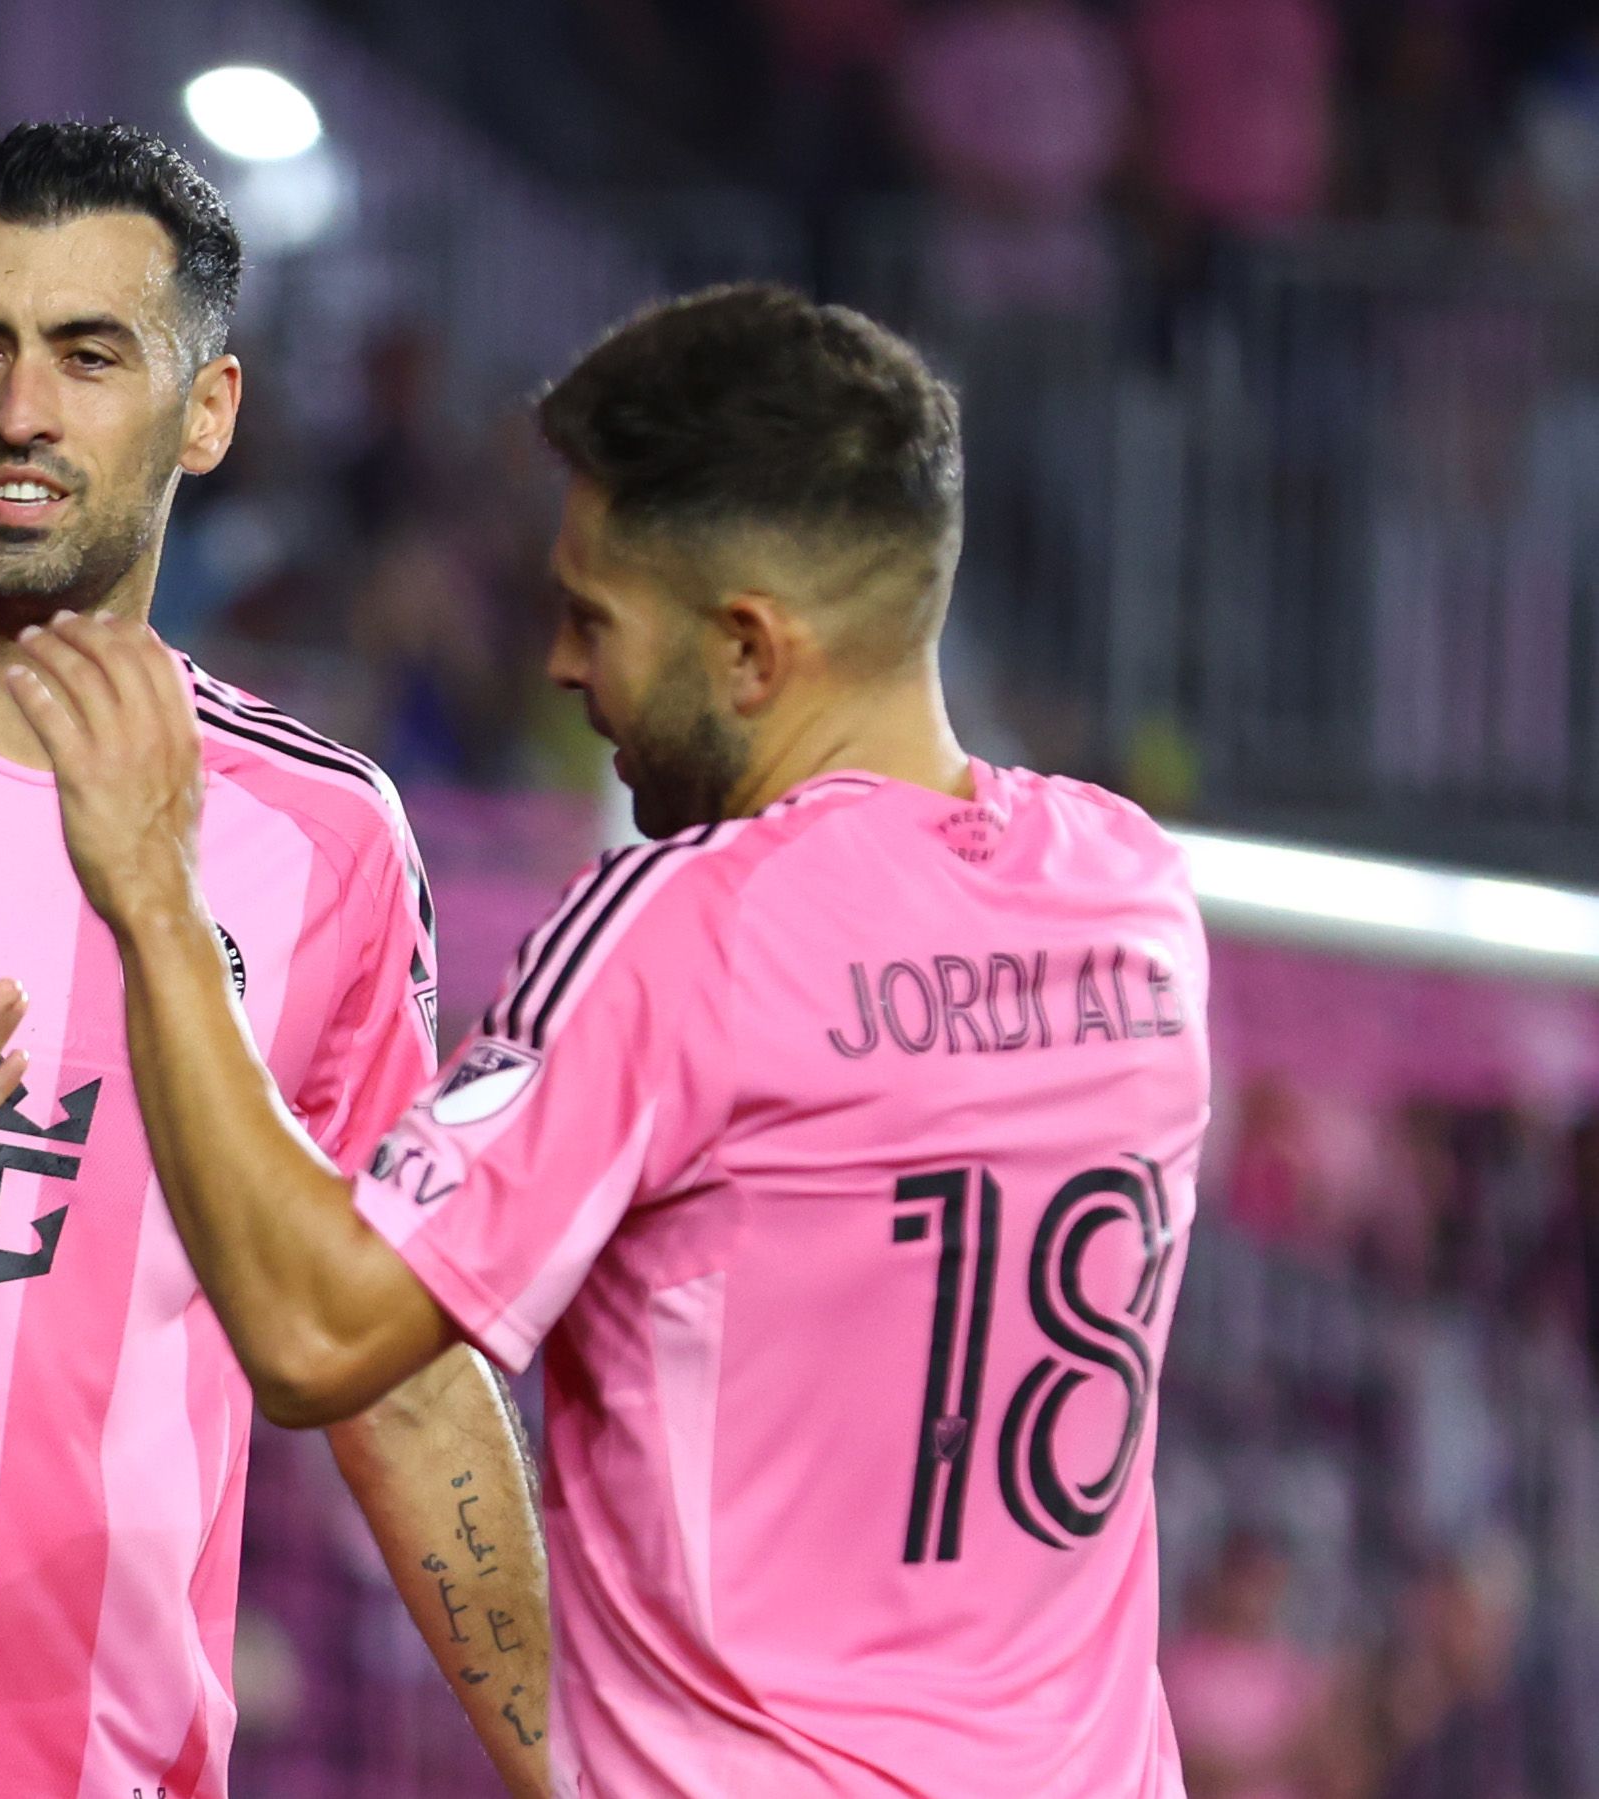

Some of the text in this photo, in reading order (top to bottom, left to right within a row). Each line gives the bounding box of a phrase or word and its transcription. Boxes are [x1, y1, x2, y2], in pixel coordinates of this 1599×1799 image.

[829, 944, 1184, 1059] JORDI ALB
[892, 1152, 1174, 1564] 18
